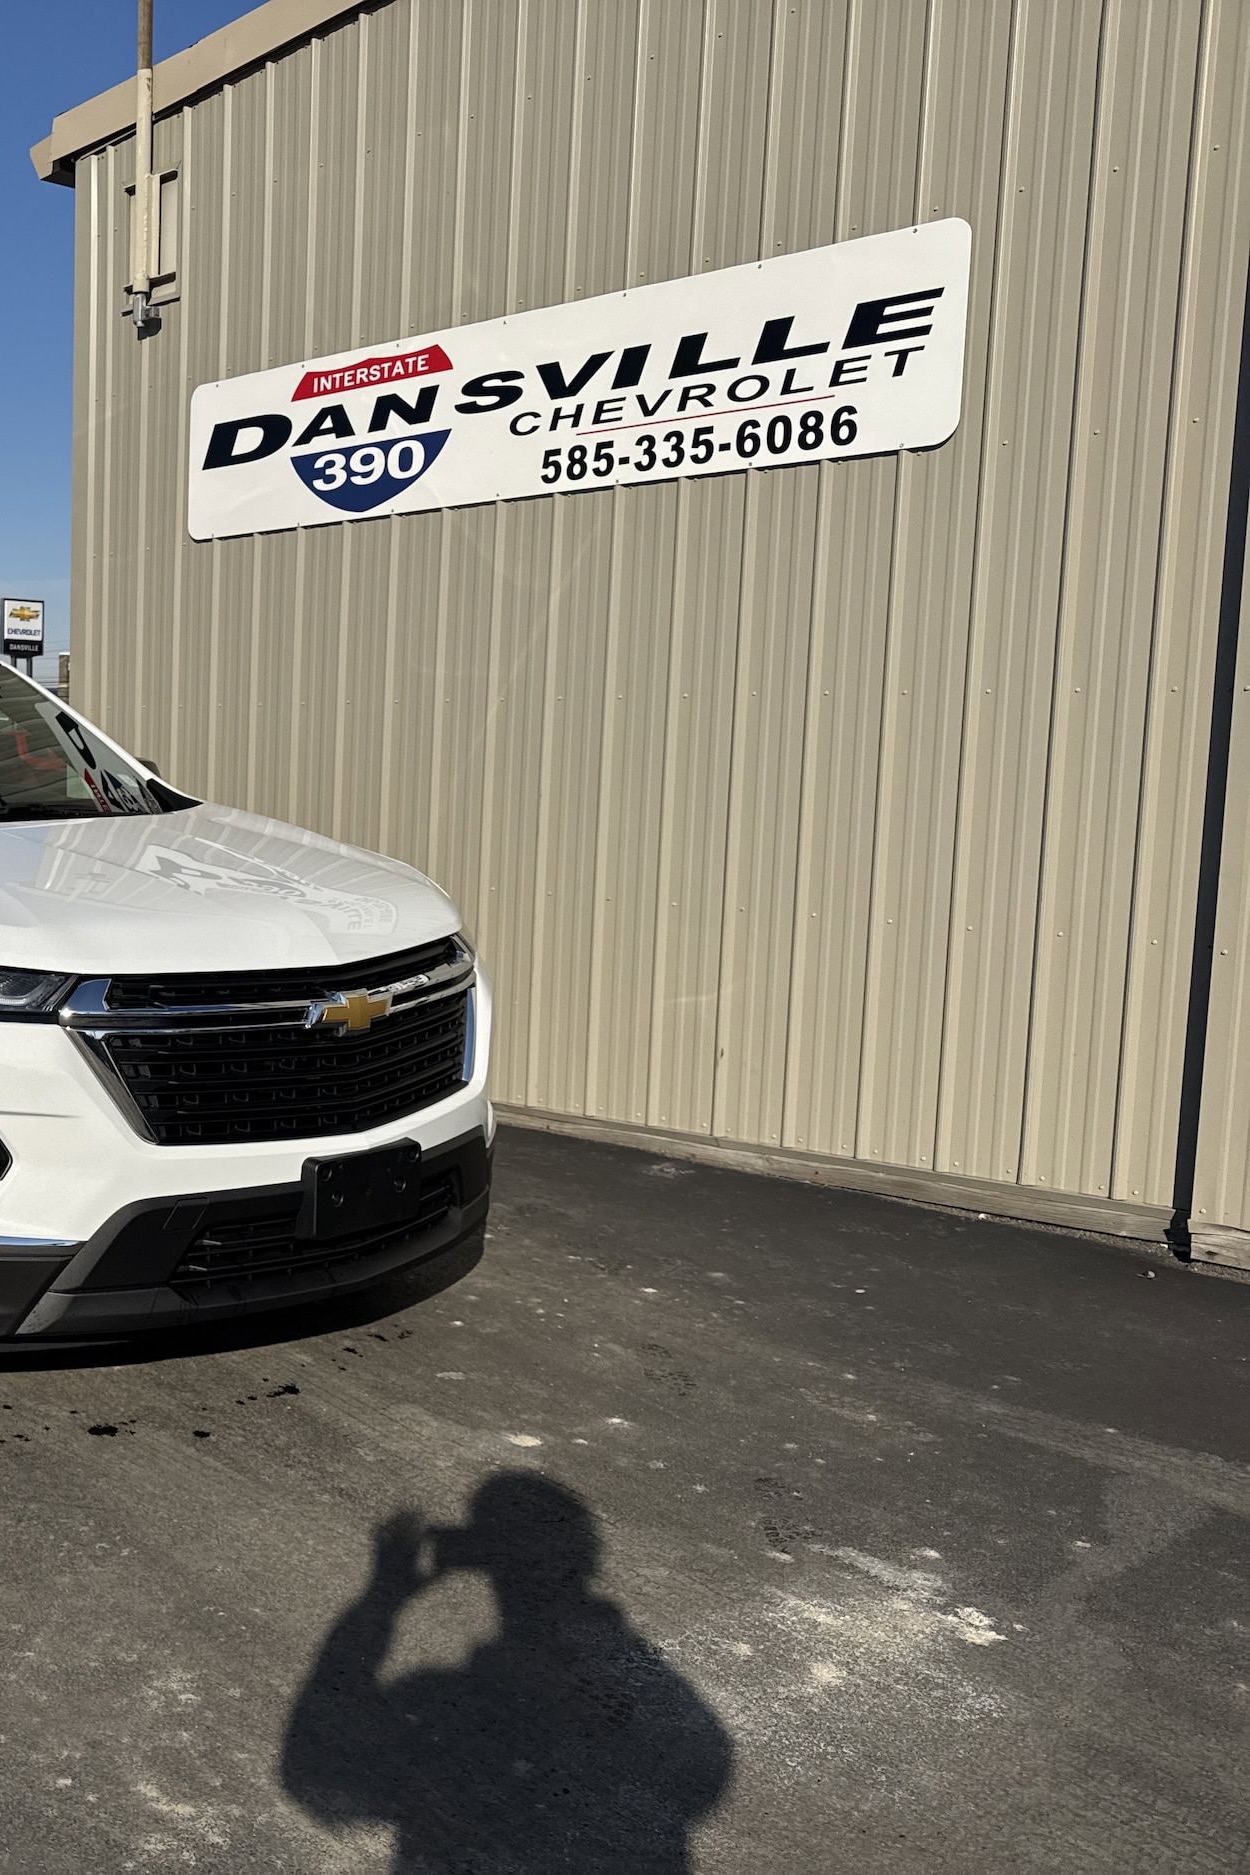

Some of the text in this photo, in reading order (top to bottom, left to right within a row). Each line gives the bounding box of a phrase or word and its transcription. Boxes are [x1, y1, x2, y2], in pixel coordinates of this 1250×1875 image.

[312, 353, 430, 394] INTERSTATE
[509, 345, 925, 437] CHEVROLET
[311, 439, 426, 492] 390
[540, 404, 859, 484] 585-335-6086
[7, 628, 42, 636] CHEVROLET
[9, 644, 40, 652] DANSVILLE
